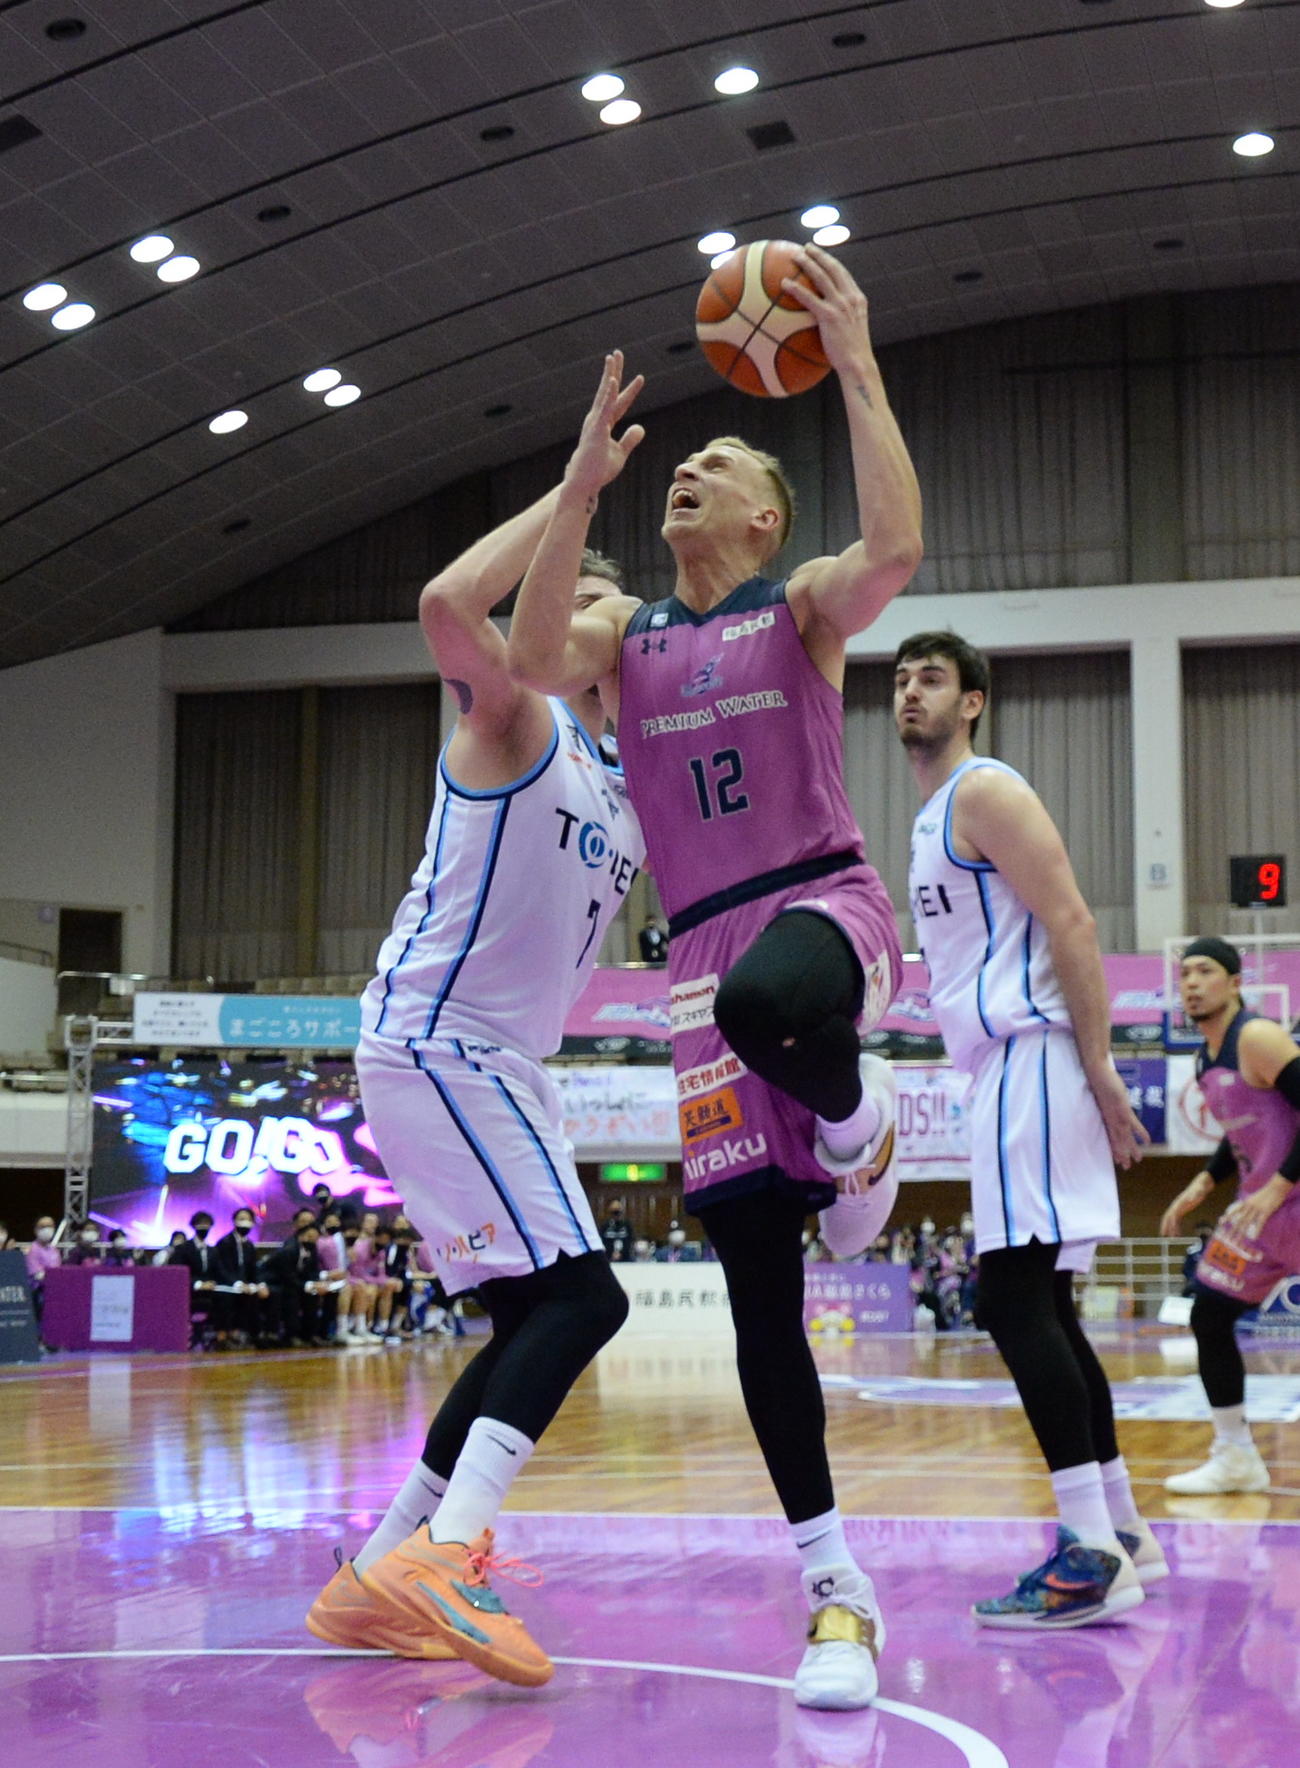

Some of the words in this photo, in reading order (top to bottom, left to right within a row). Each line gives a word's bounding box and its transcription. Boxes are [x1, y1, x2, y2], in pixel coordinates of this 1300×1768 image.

[640, 707, 716, 739] PREMIUM
[715, 690, 789, 719] WATER
[690, 748, 749, 823] 12
[1257, 862, 1281, 900] 9
